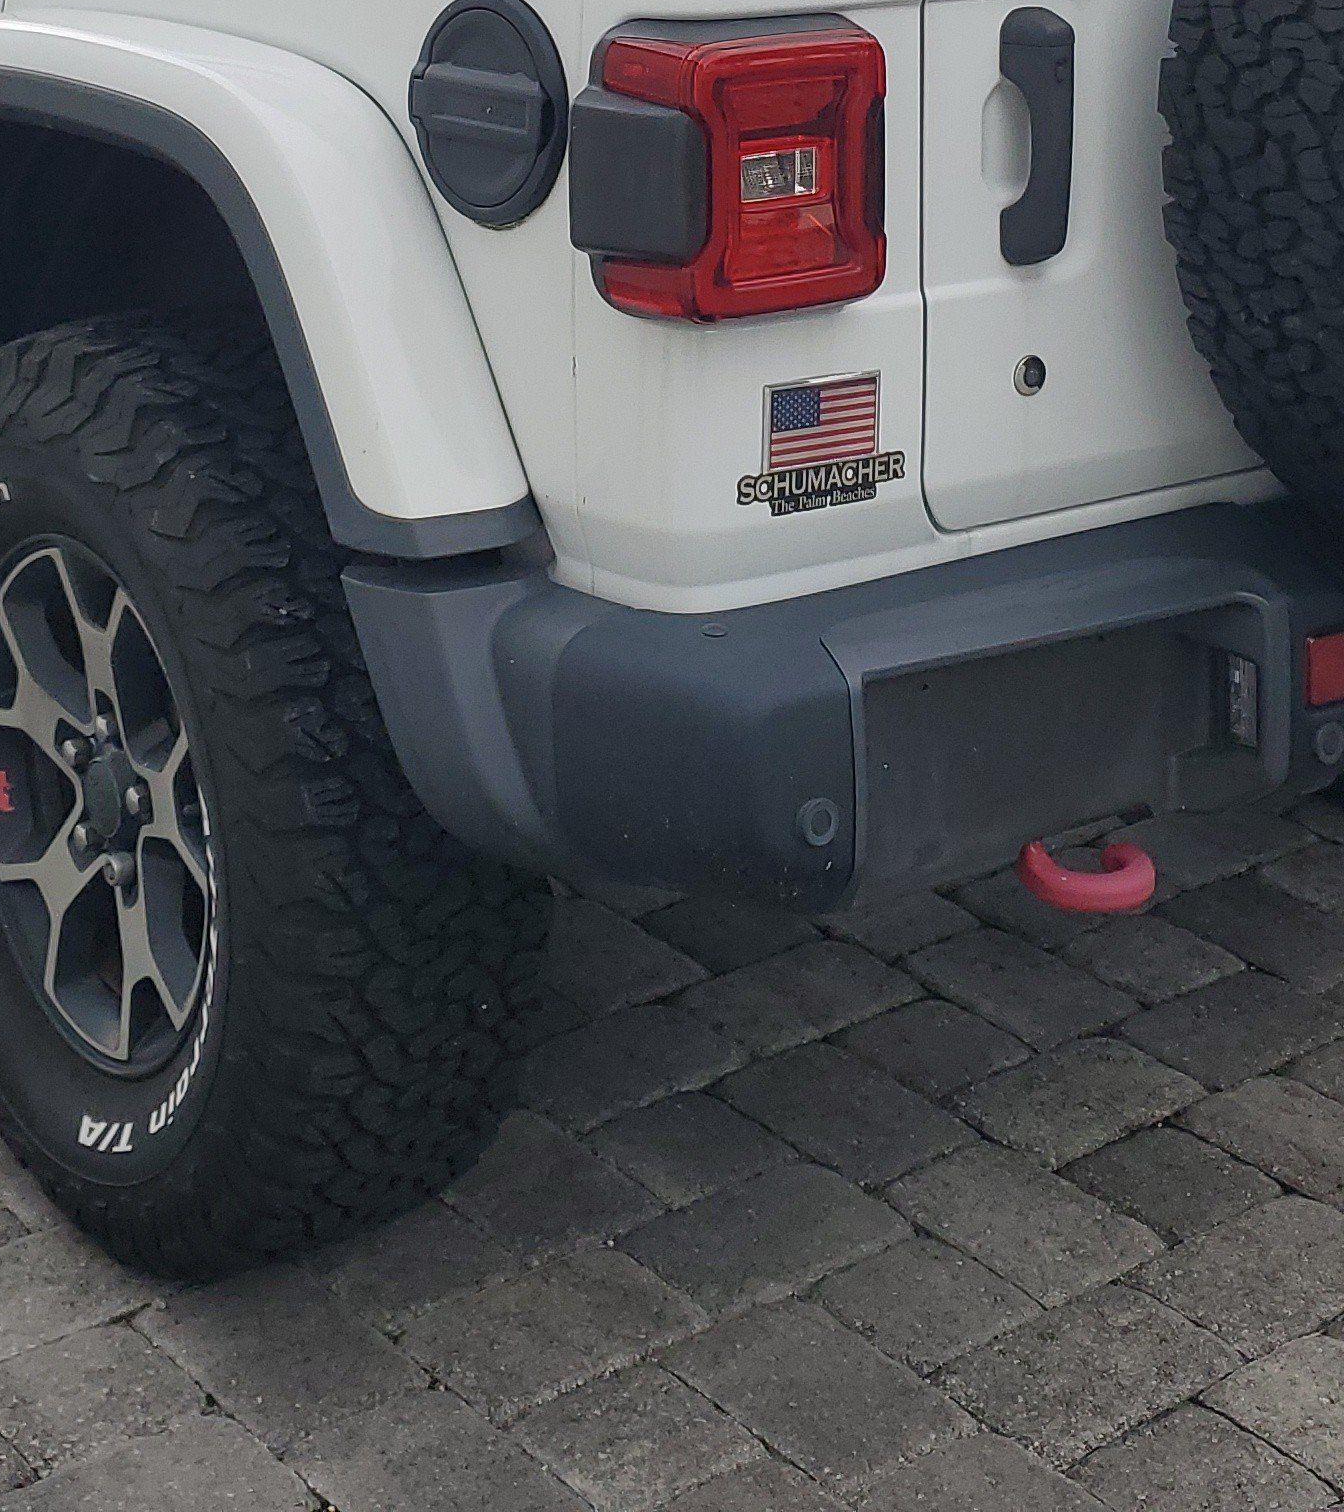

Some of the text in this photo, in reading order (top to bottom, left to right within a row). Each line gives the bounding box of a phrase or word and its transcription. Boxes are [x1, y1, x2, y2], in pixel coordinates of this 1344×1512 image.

[739, 454, 905, 503] SCHUMACHER
[771, 487, 875, 514] The Palm Beaches
[78, 1115, 134, 1153] T/A
